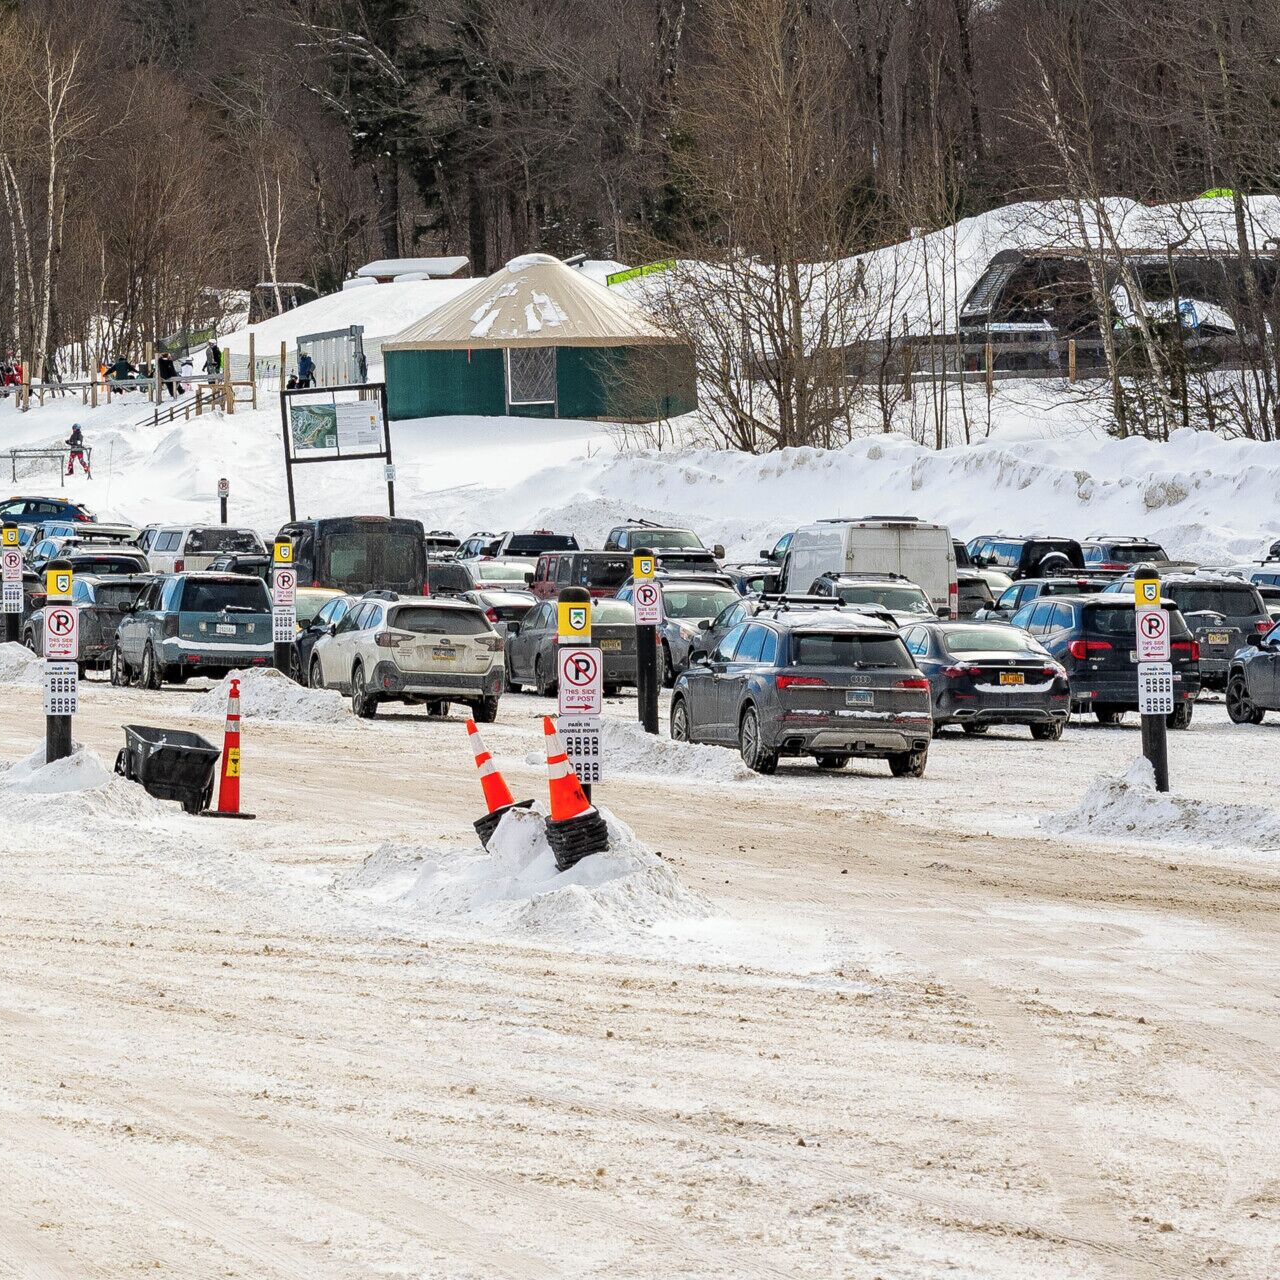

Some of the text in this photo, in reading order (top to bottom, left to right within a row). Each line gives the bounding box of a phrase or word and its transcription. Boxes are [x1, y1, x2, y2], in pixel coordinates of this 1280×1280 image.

[643, 589, 653, 602] P
[57, 615, 69, 631] P
[1149, 618, 1160, 634] P
[574, 659, 590, 680] P
